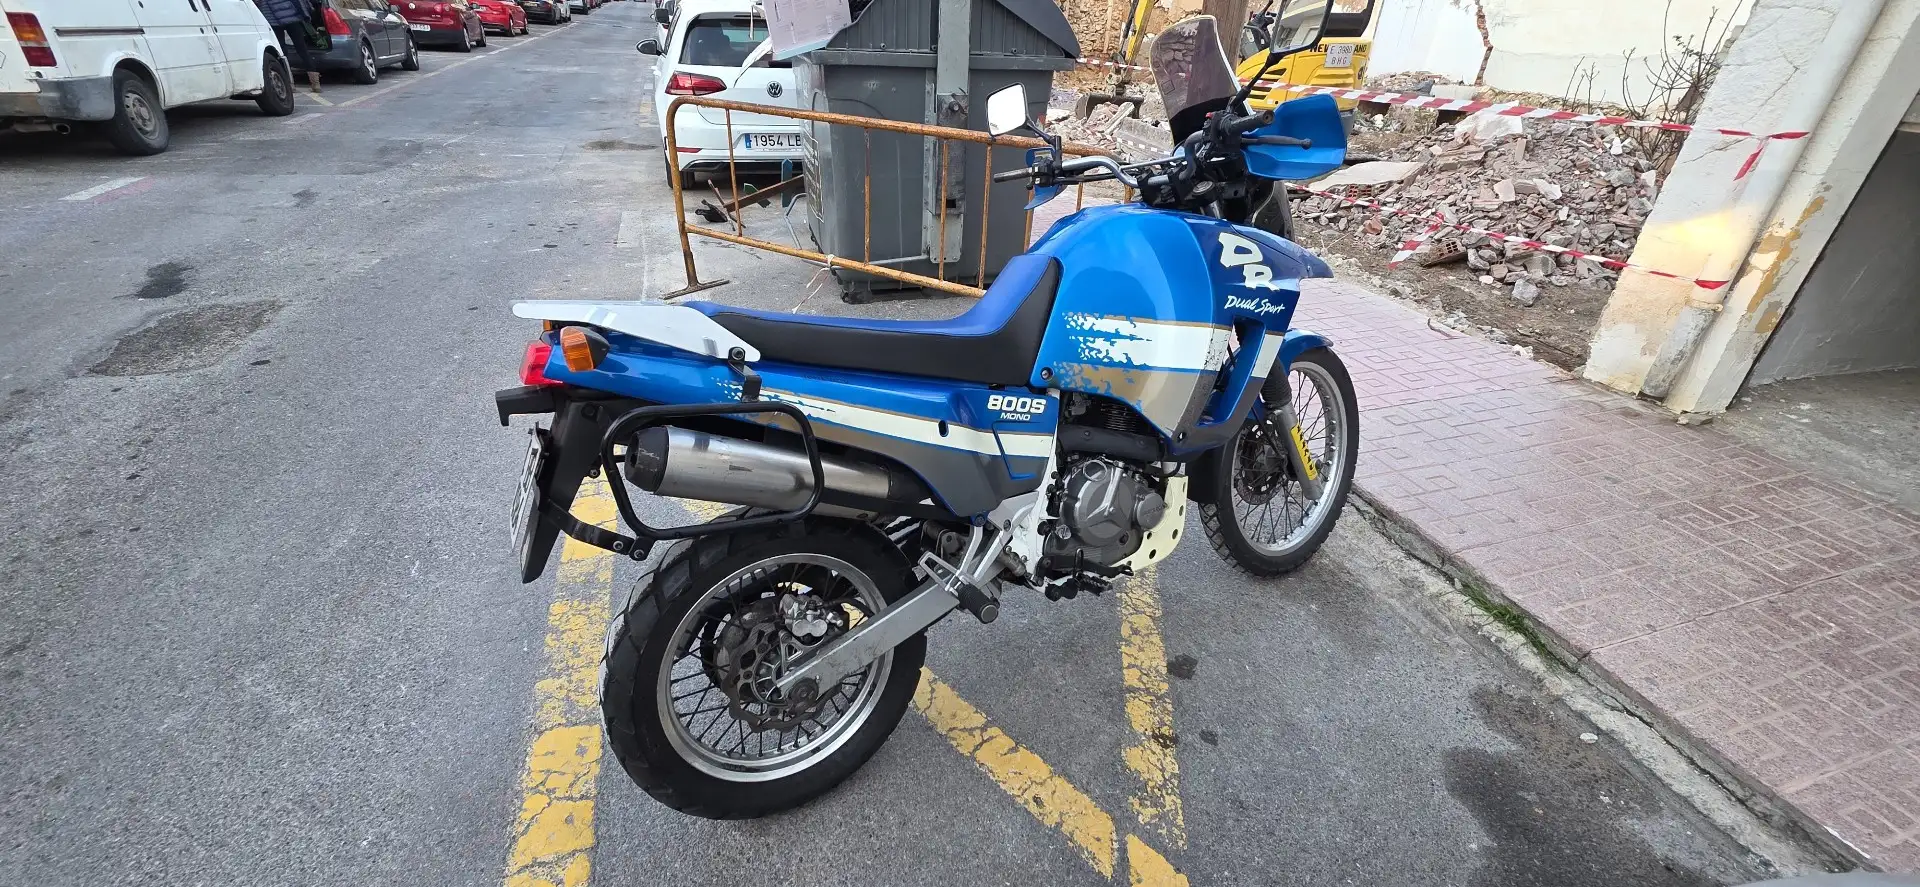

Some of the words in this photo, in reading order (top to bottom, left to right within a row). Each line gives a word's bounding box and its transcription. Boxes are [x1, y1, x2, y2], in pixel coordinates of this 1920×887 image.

[754, 135, 783, 146] 1954
[1218, 232, 1280, 291] DR
[1255, 299, 1285, 316] Sport
[987, 394, 1047, 414] 800S
[1000, 412, 1031, 421] MONO
